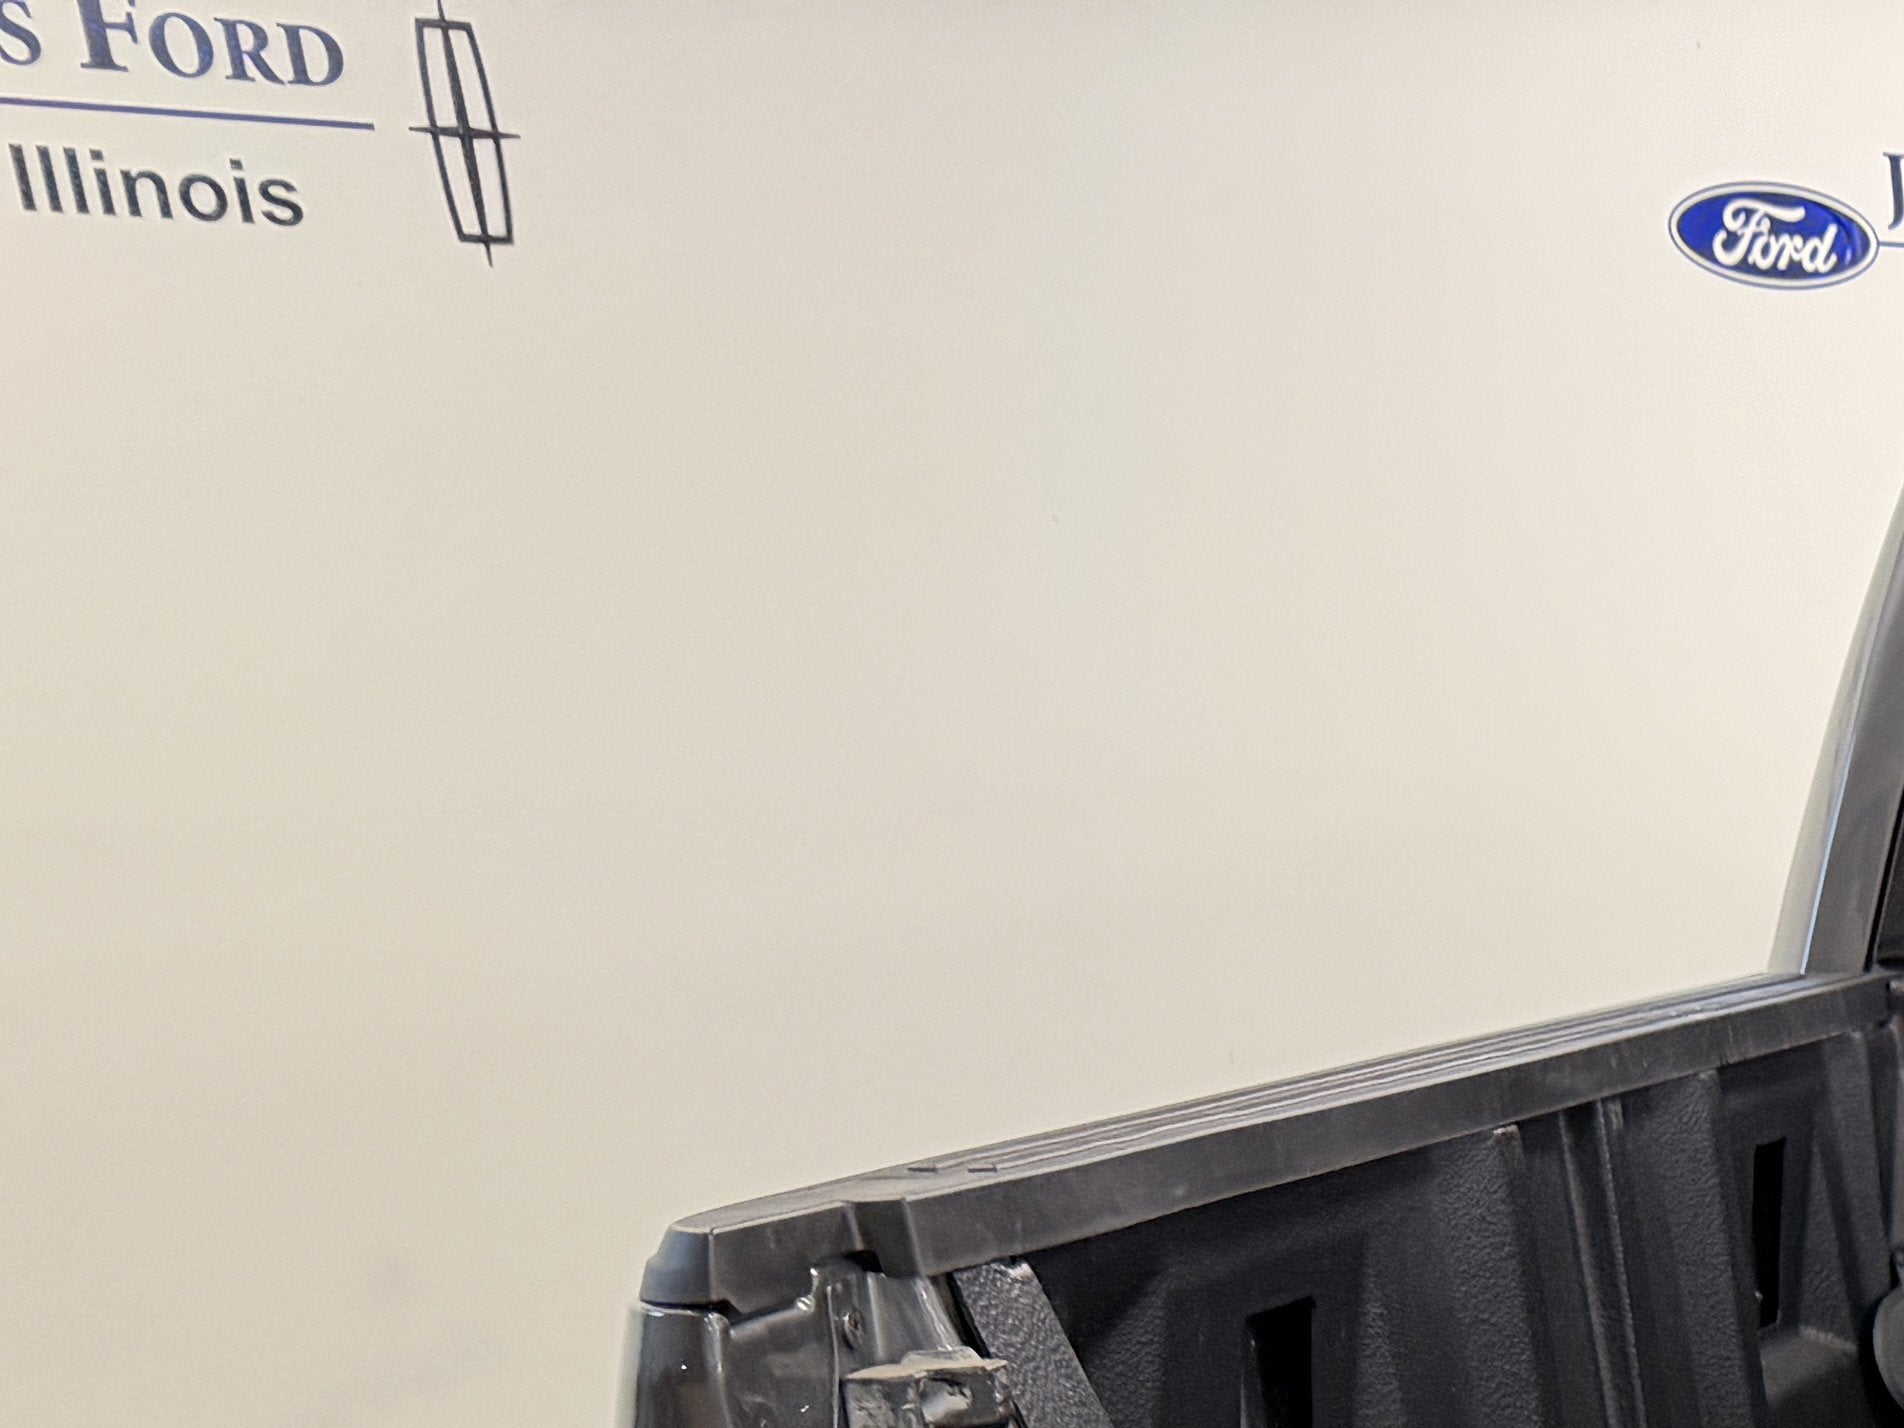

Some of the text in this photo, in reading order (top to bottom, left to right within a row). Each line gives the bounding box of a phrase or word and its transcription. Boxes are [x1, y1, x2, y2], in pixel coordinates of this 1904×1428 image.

[76, 0, 345, 87] FORD
[8, 143, 304, 227] Illinois
[1712, 198, 1838, 274] Ford
